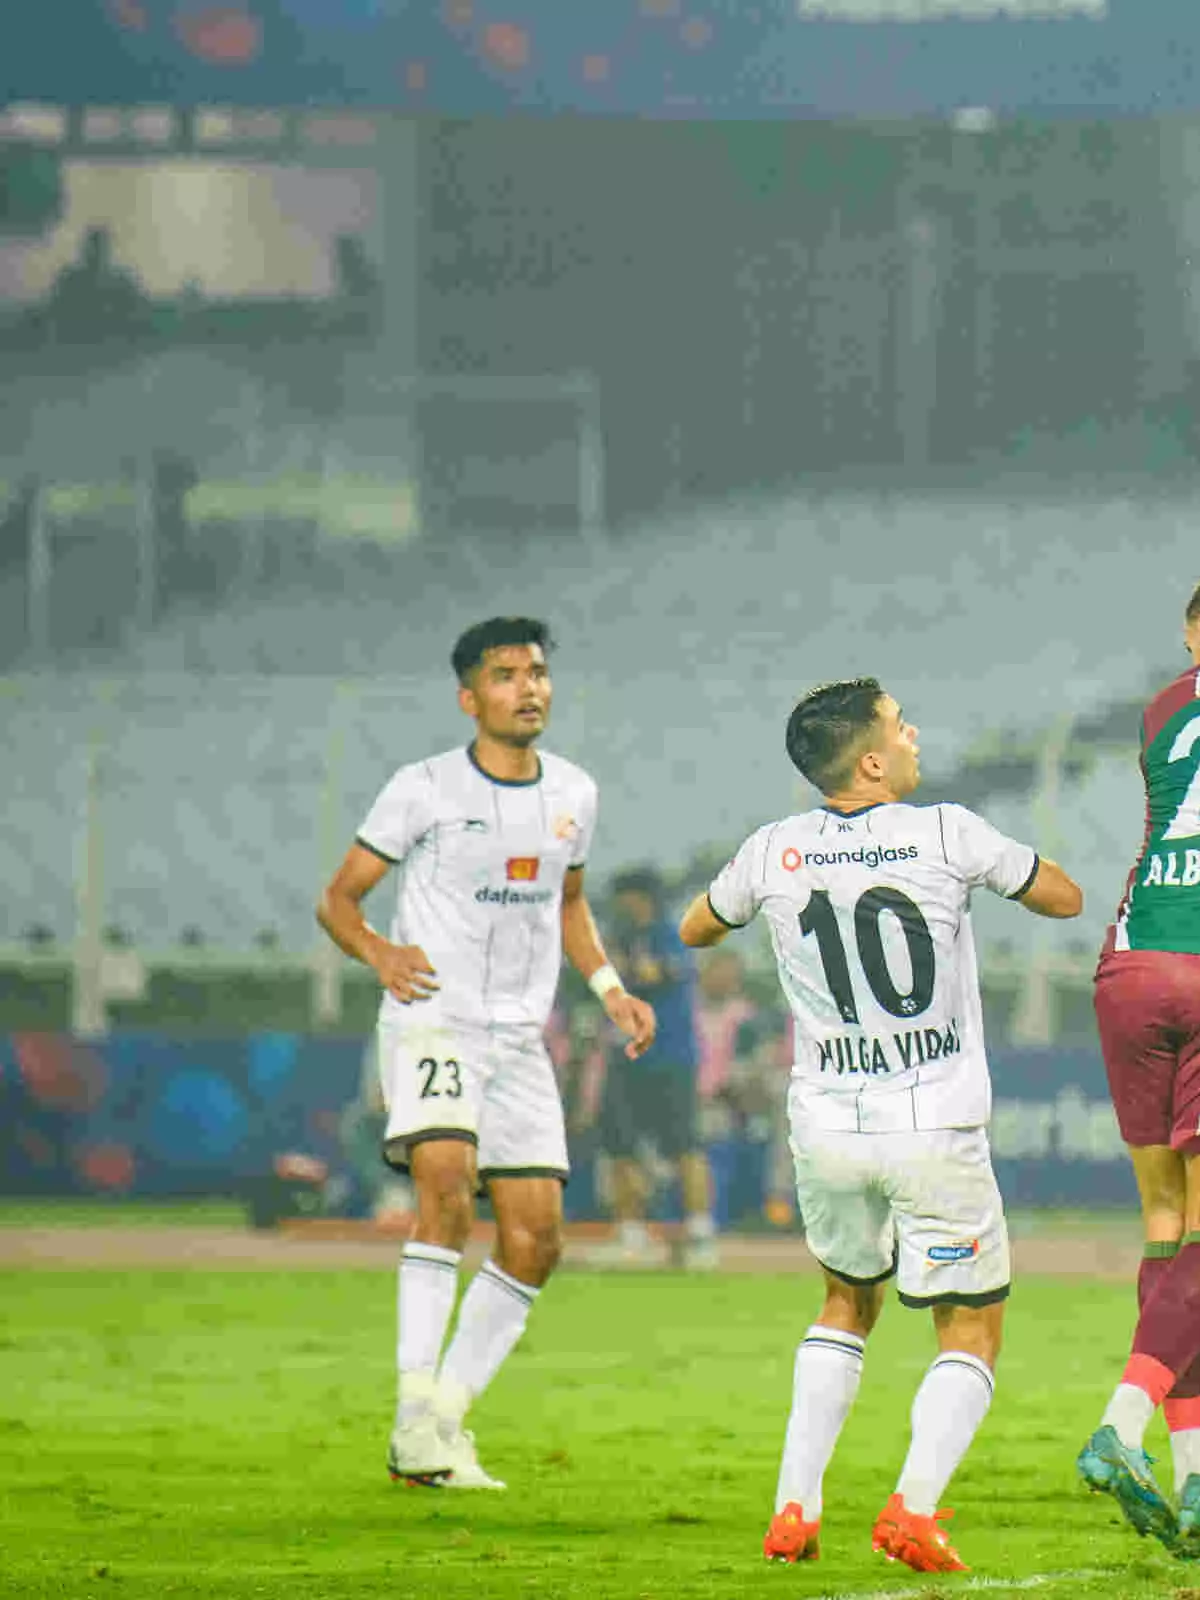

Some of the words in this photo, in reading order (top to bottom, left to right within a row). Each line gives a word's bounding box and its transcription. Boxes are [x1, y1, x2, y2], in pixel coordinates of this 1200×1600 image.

[804, 845, 918, 868] roundglass
[798, 887, 935, 1024] 10
[417, 1058, 462, 1099] 23
